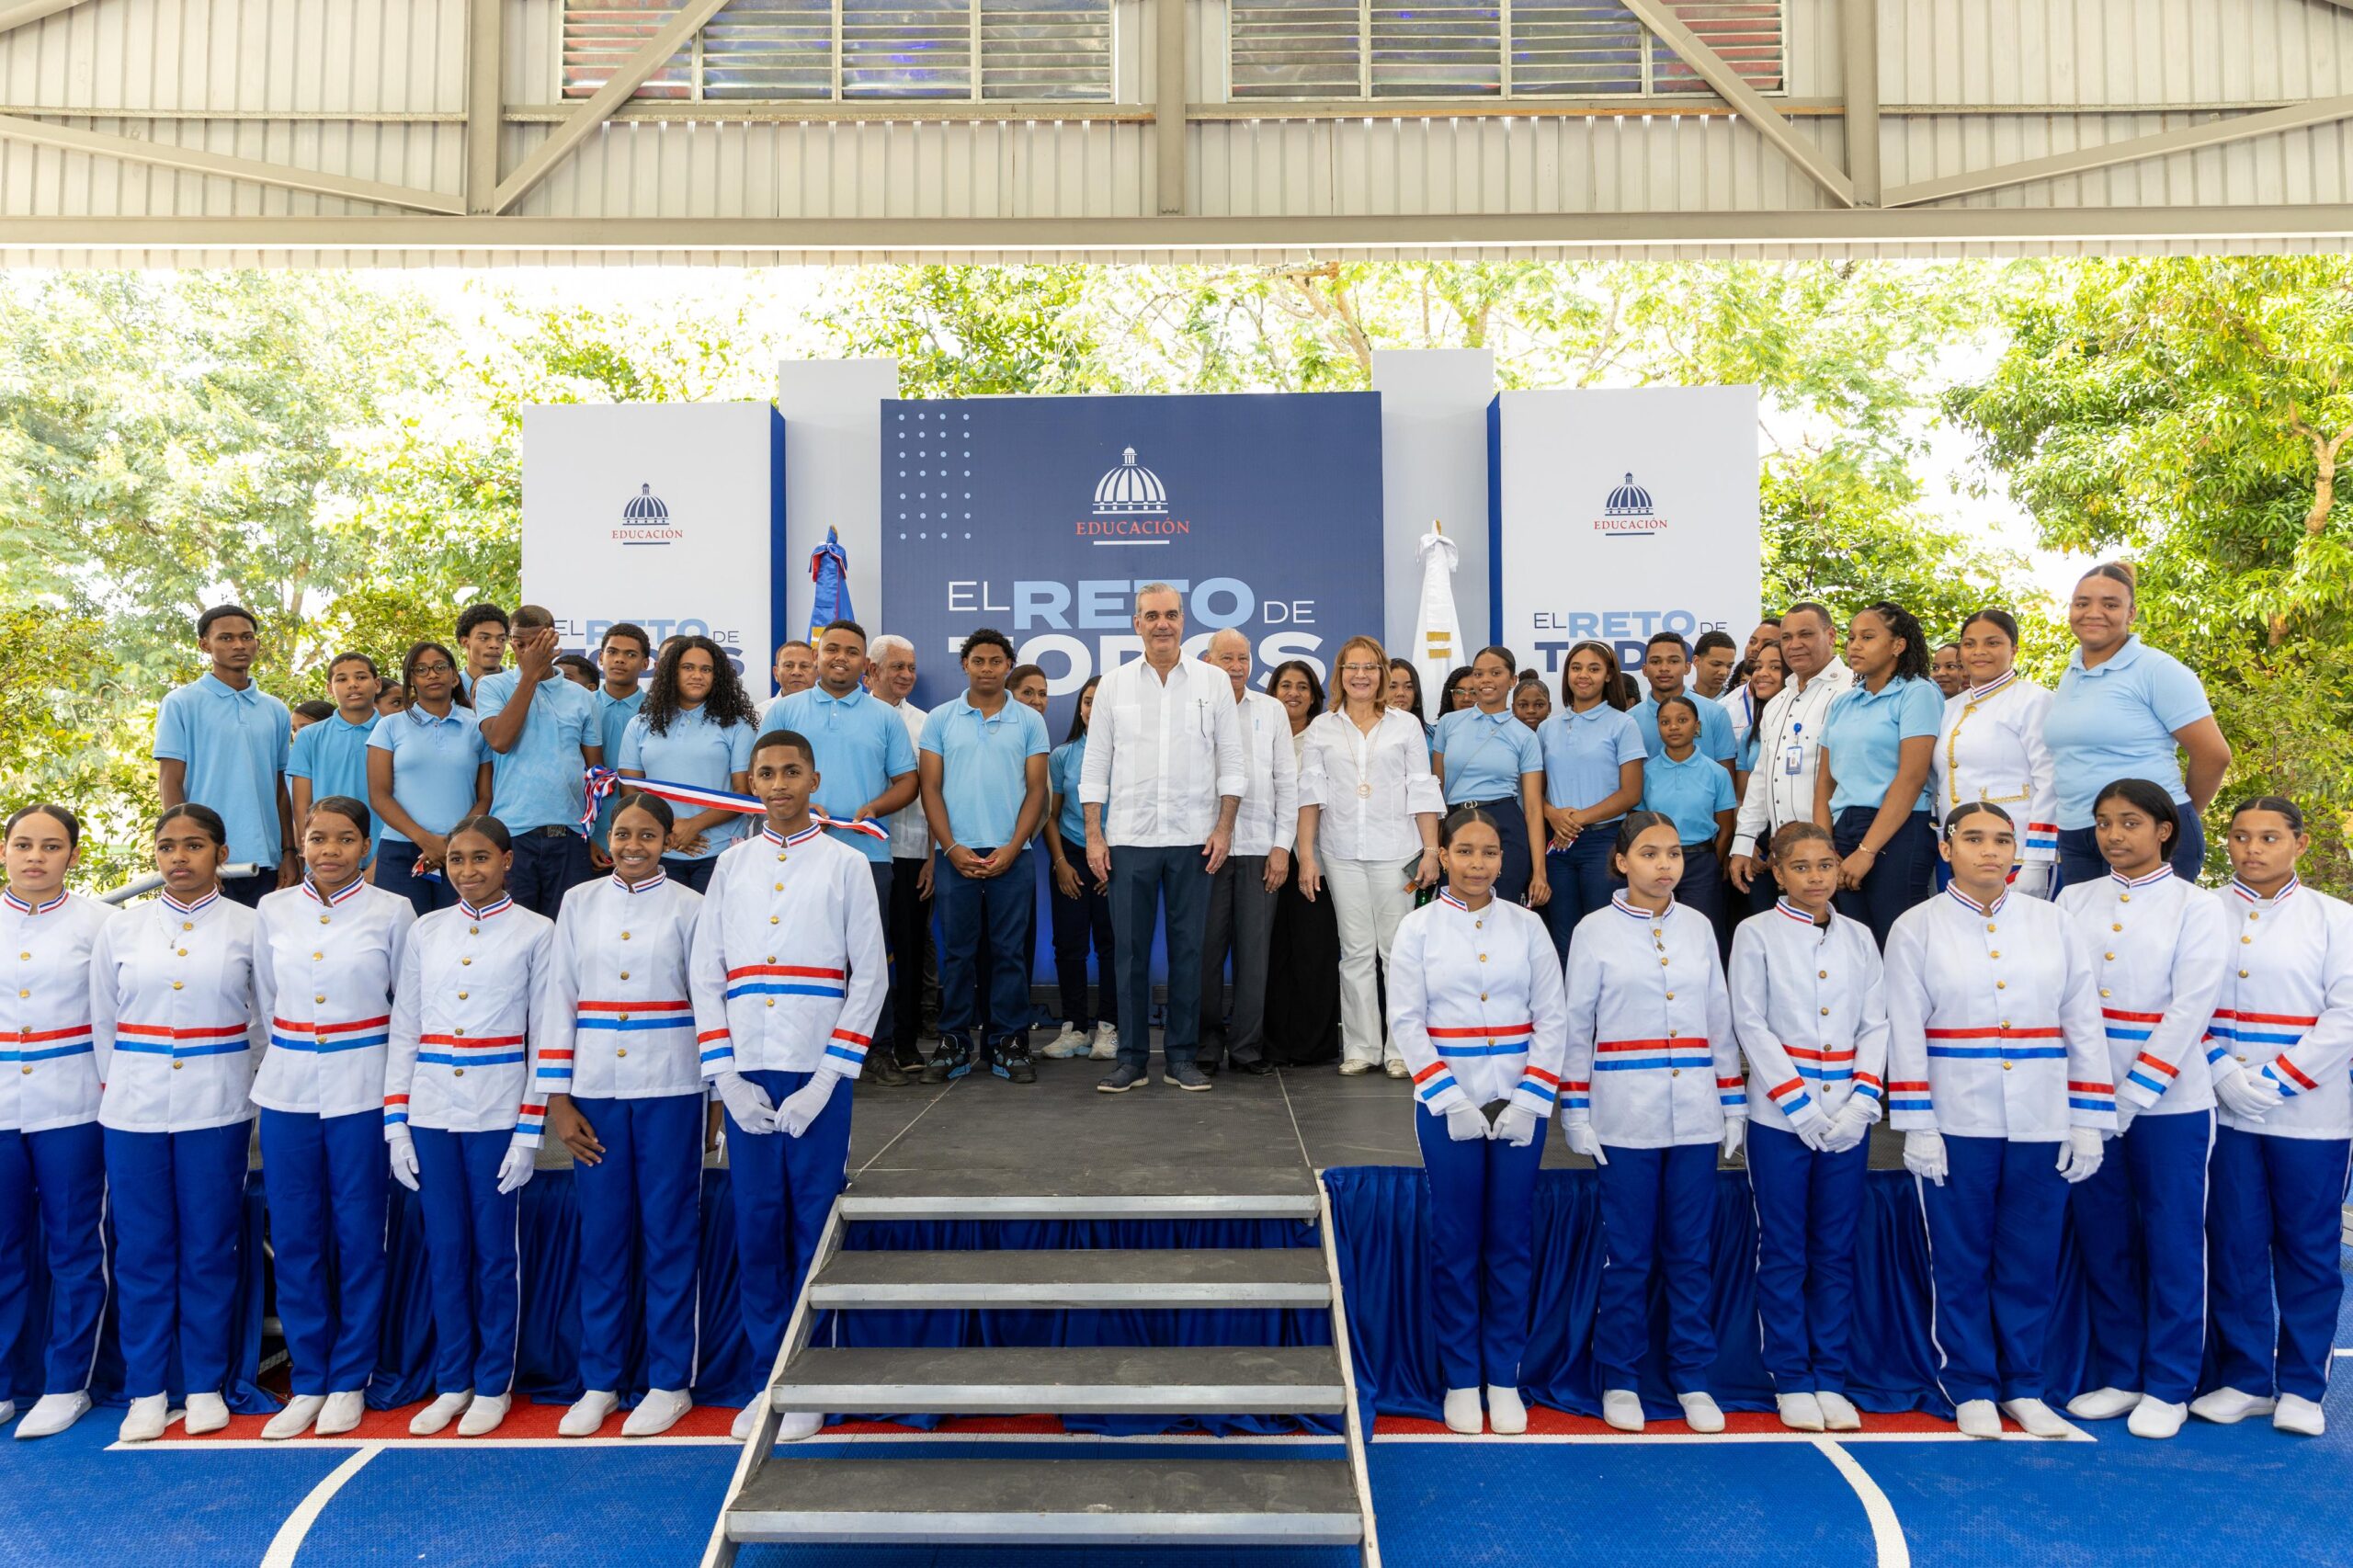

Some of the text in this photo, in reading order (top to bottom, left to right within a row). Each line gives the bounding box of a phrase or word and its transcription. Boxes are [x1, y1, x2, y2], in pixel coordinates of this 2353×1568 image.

[612, 528, 683, 540] EDUCACIÓN
[1075, 517, 1189, 536] EDUCACIÓN
[1594, 517, 1667, 530] EDUCACIÓN
[949, 581, 1010, 611] EL
[1264, 600, 1315, 624] DE
[586, 619, 709, 645] RTO
[713, 631, 740, 643] DE
[1534, 609, 1727, 638] EL RETO DE
